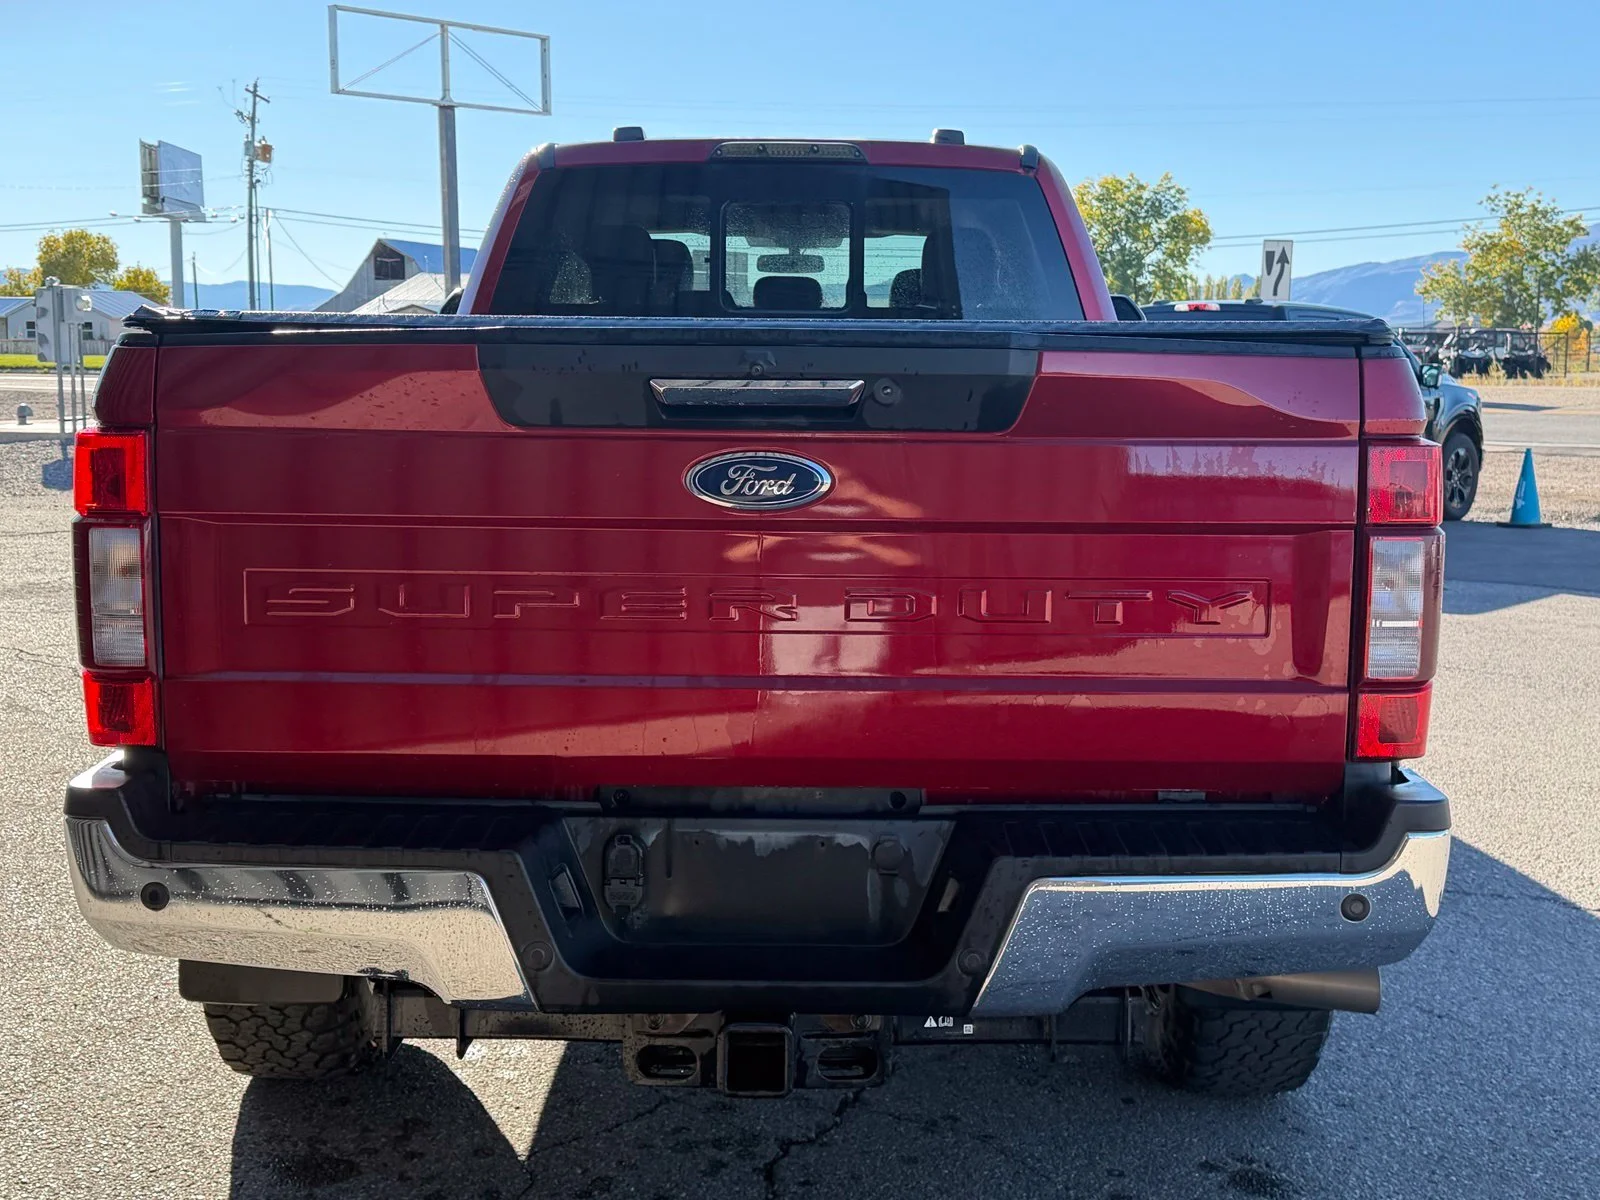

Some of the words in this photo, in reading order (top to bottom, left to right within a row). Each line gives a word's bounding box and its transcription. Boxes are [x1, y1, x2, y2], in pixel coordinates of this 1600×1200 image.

[719, 463, 797, 496] Ford
[264, 582, 799, 622] SUPER
[843, 586, 1254, 625] DUTY
